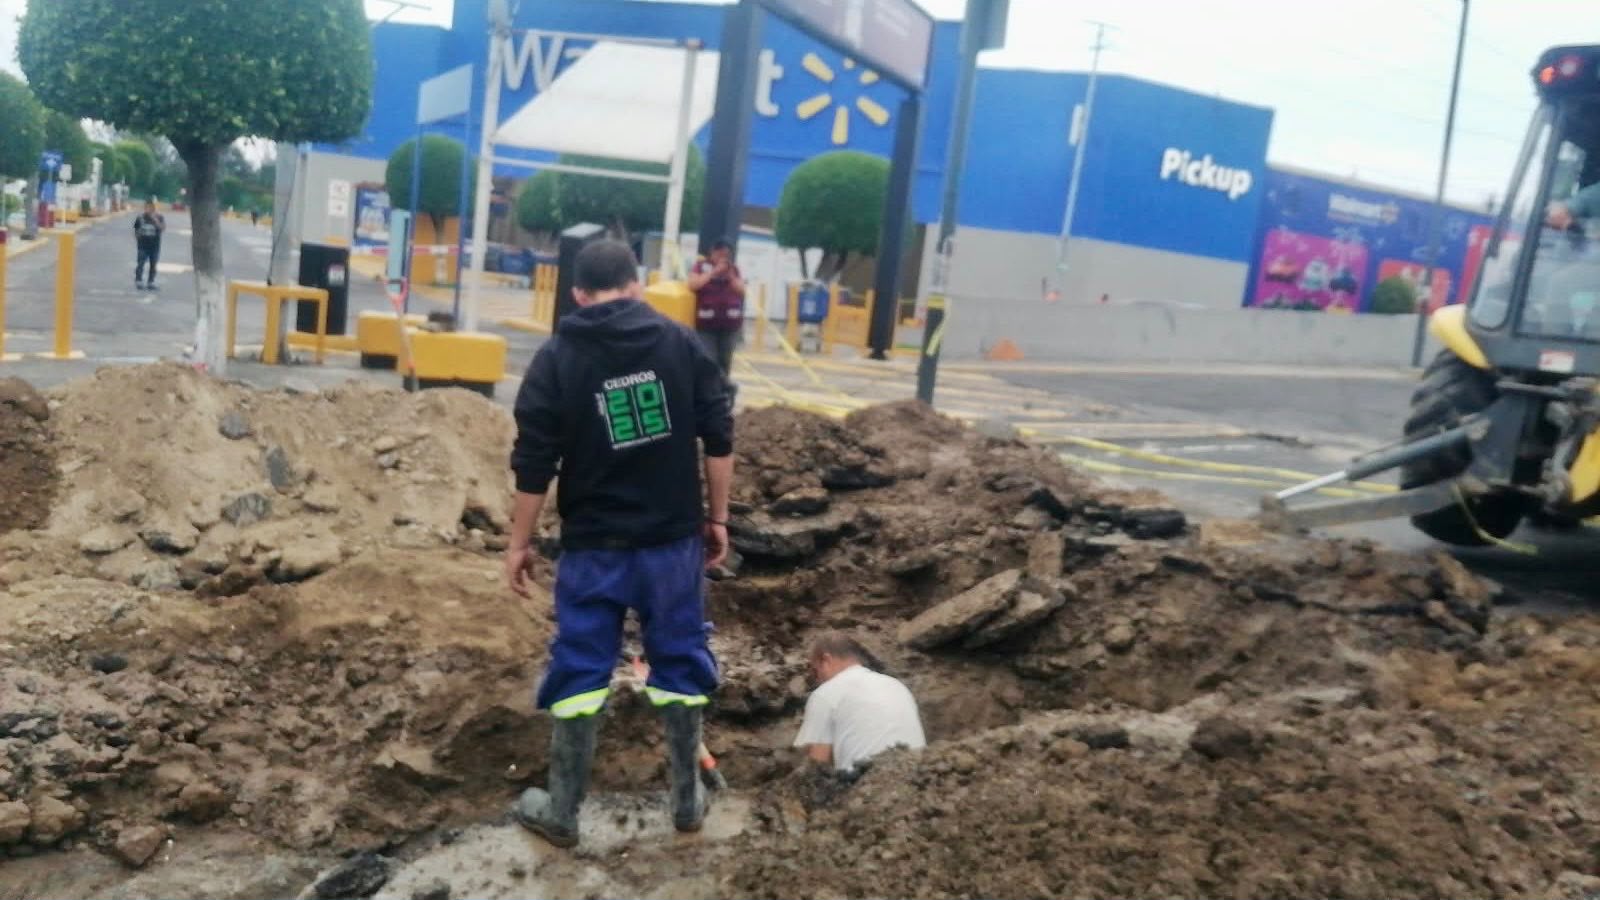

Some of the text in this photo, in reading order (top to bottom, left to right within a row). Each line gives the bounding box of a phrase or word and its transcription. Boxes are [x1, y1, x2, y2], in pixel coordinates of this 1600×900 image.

[1161, 148, 1251, 200] Pickup
[603, 370, 656, 390] CEDROS
[608, 383, 660, 415] 20
[613, 409, 665, 441] 25
